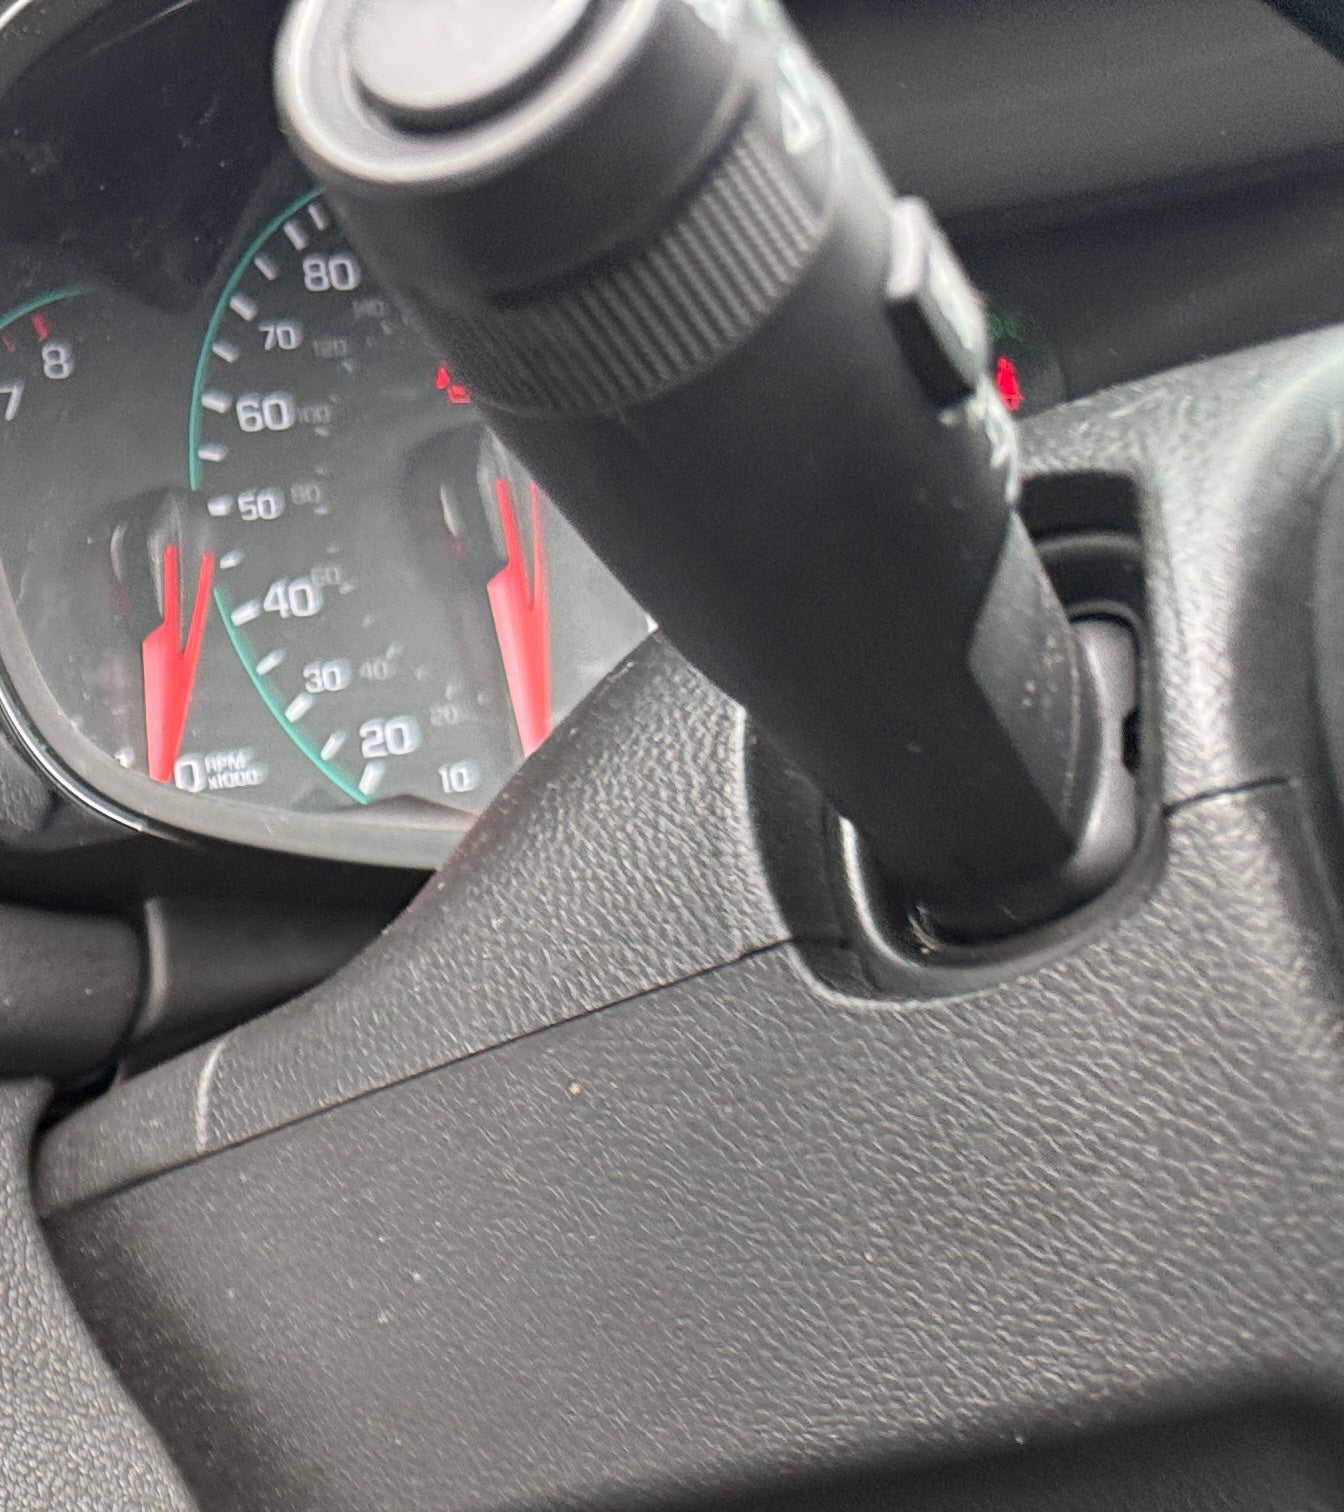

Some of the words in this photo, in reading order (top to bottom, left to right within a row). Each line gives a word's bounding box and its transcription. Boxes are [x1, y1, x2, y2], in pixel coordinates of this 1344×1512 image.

[302, 253, 360, 291] 80
[258, 320, 302, 350] 70
[41, 338, 74, 380] 8
[236, 391, 295, 432] 60
[237, 486, 285, 521] 50
[263, 577, 322, 618] 40
[302, 659, 352, 694] 30
[359, 715, 421, 759] 20
[173, 755, 207, 793] 0
[438, 760, 480, 793] 10
